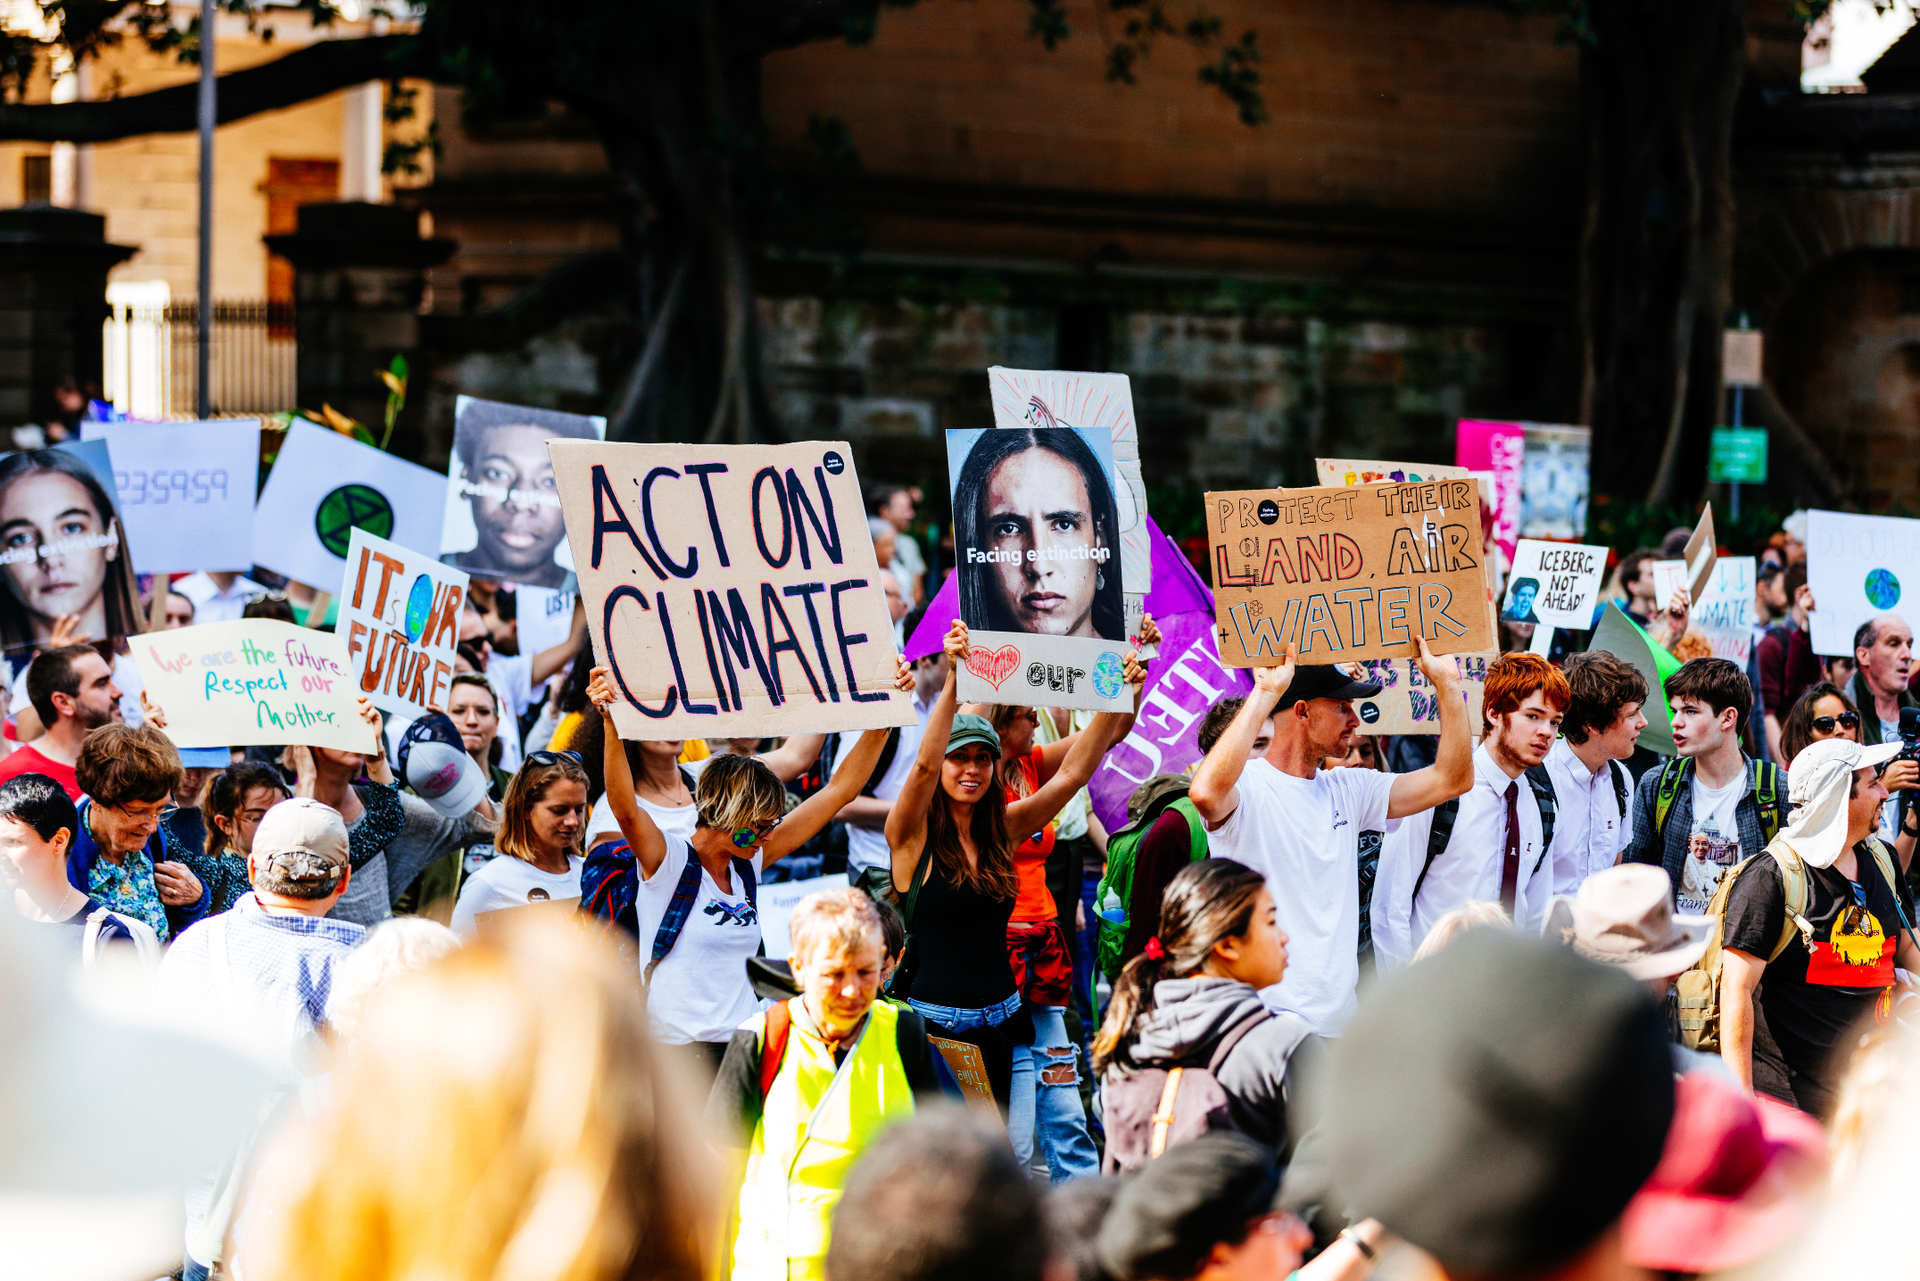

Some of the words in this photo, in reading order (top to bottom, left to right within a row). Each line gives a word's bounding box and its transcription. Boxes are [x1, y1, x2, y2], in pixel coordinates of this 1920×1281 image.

[590, 461, 731, 581] ACT
[750, 465, 844, 570] ON
[1218, 490, 1360, 533] PRTECT
[1377, 482, 1471, 517] THEIR
[966, 547, 1022, 566] Facing
[1026, 544, 1111, 561] extinction
[1550, 574, 1578, 593] NOT
[1229, 583, 1469, 658] WATER
[149, 646, 192, 674] We
[200, 650, 236, 667] are
[241, 638, 277, 666] the
[349, 619, 451, 707] FUTURE
[603, 579, 891, 720] CLIMATE
[205, 668, 288, 703] Respect
[1027, 662, 1086, 694] our
